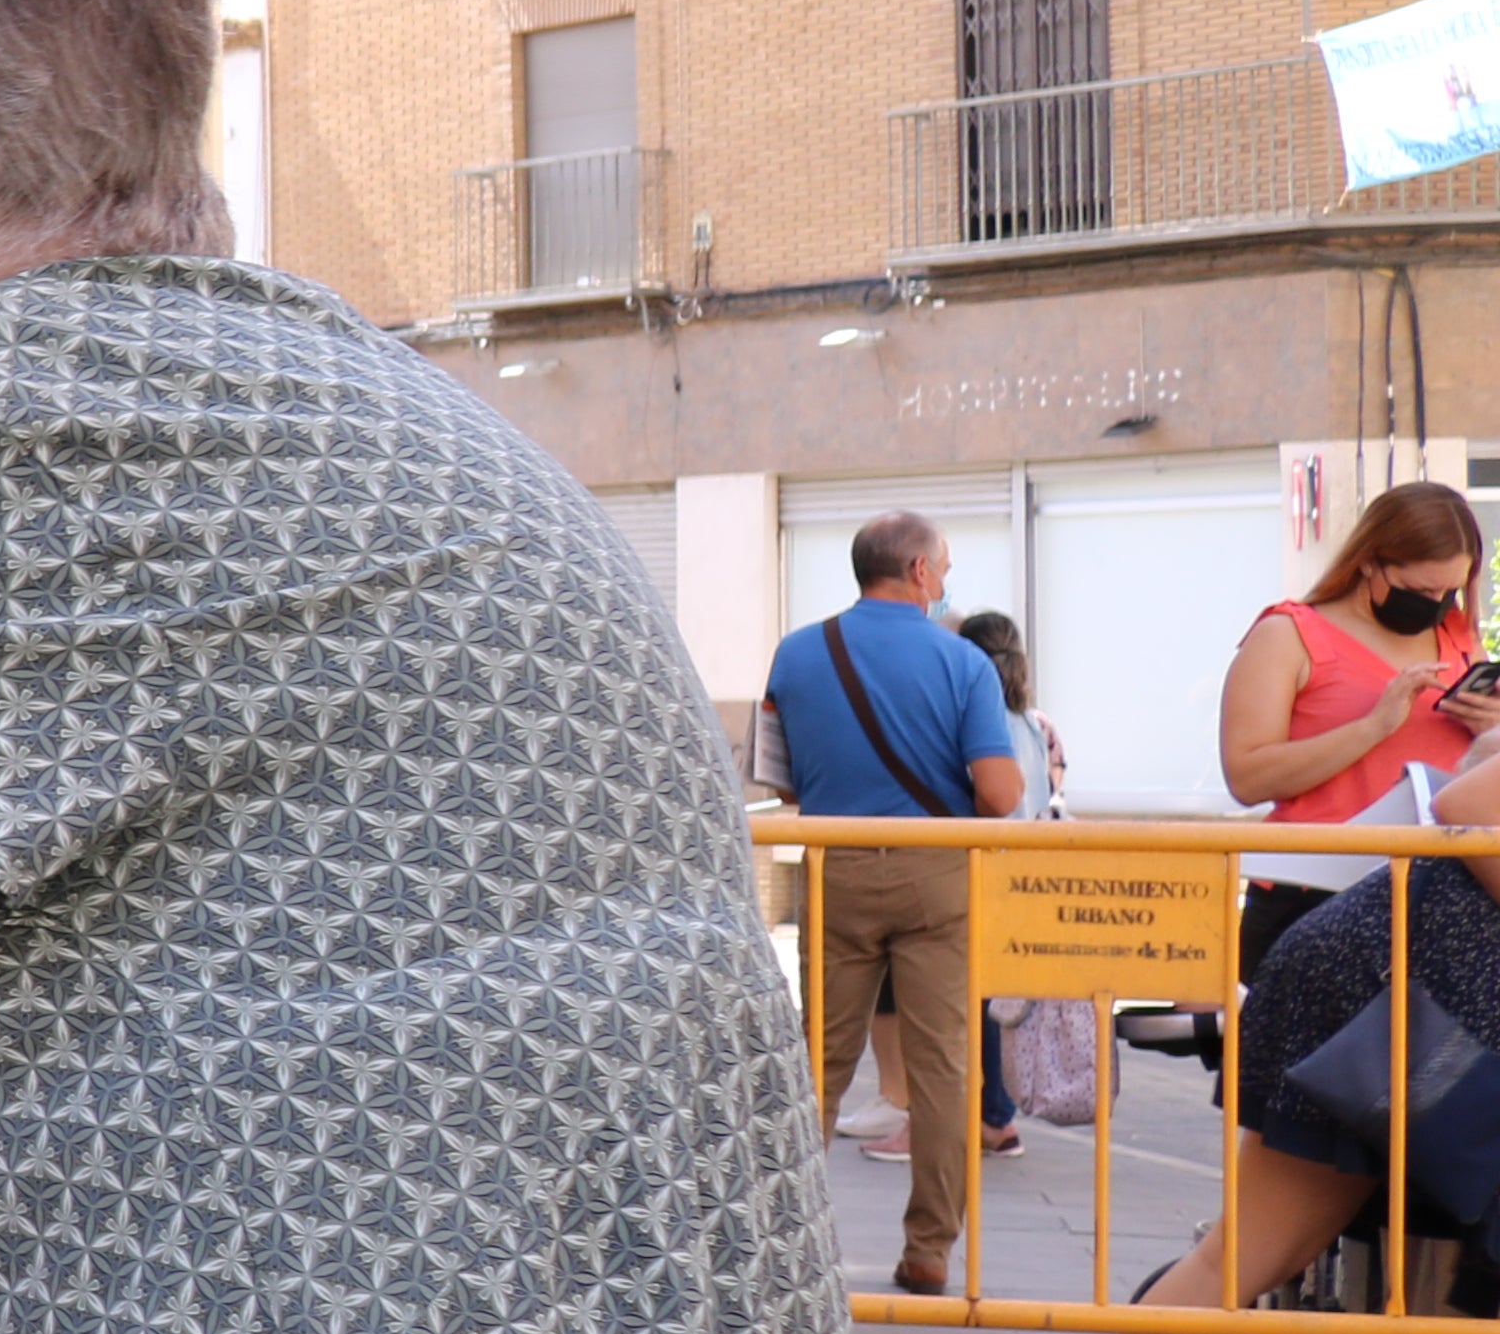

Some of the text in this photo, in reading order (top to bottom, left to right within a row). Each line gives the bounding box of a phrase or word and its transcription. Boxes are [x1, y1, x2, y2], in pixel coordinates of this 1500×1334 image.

[1008, 874, 1209, 901] MANTENIMIENTO
[1057, 905, 1155, 927] URBANO
[1136, 939, 1160, 960] de
[1166, 942, 1207, 963] Jaén
